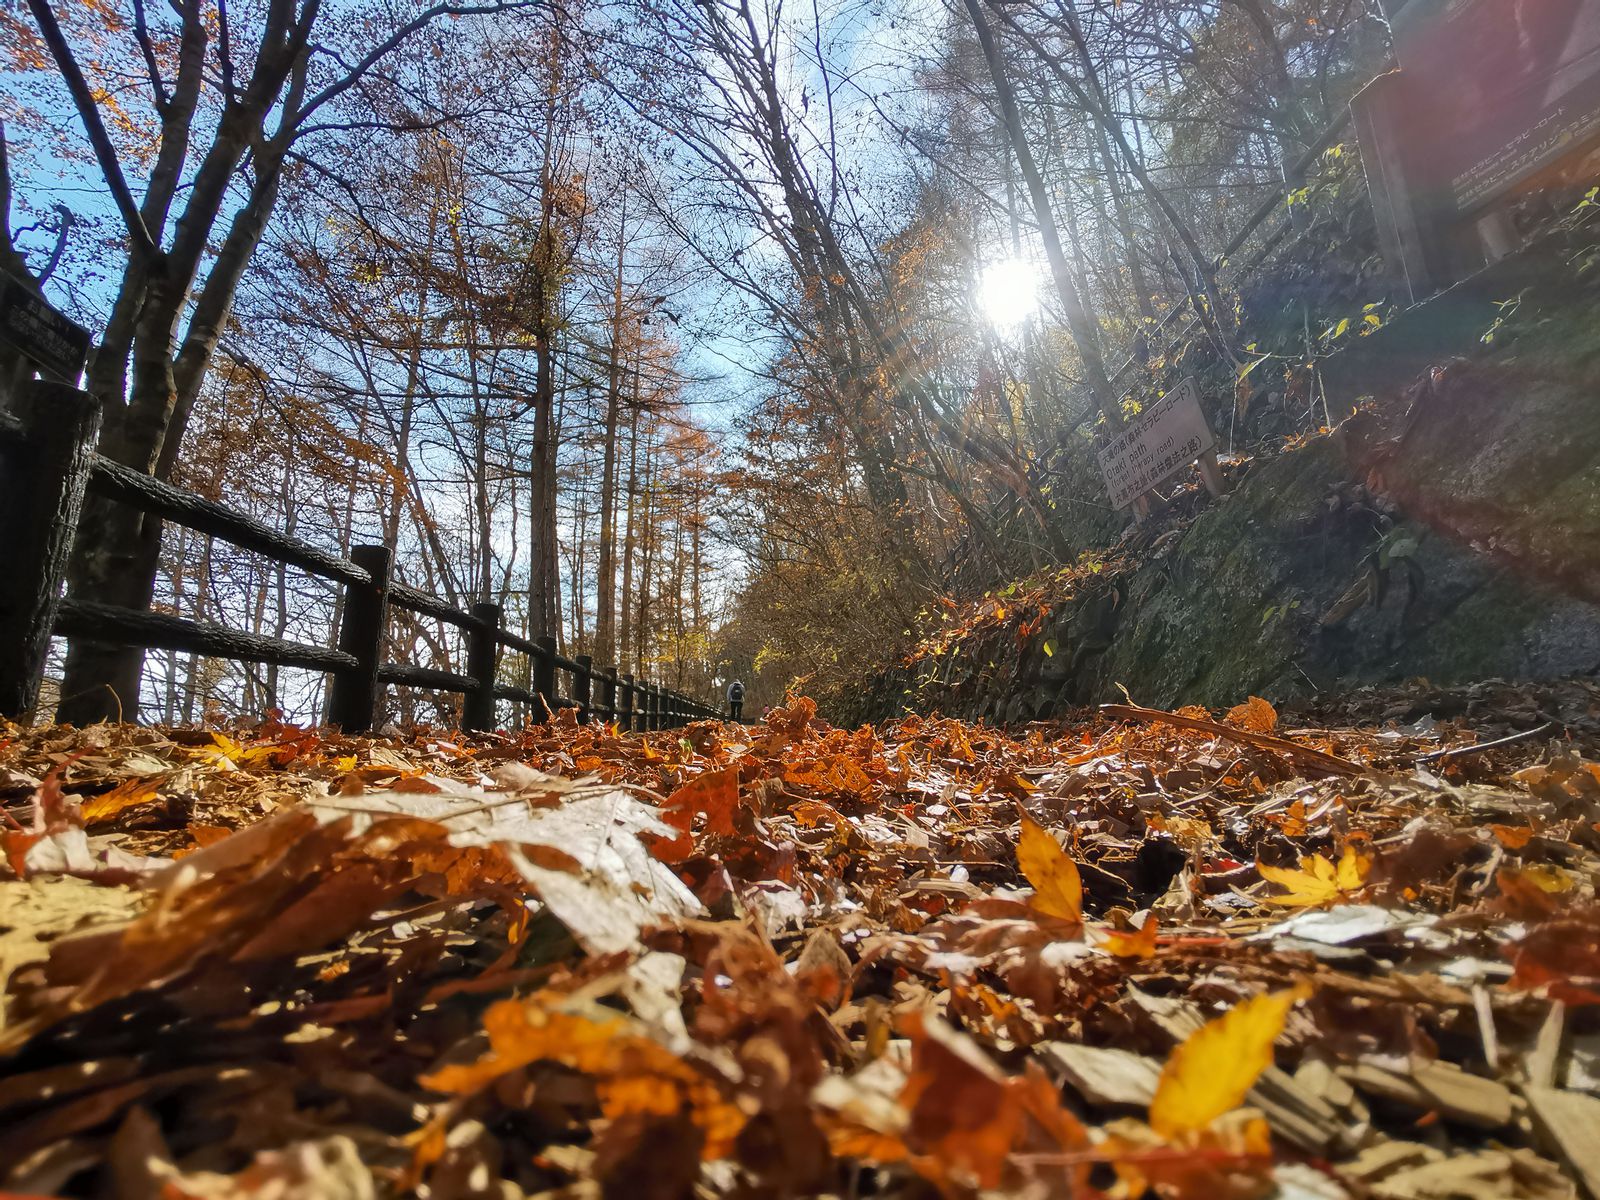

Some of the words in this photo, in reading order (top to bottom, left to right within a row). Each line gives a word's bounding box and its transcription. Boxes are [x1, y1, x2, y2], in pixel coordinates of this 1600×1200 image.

[1156, 435, 1176, 455] road)
[1106, 457, 1128, 480] Otaki
[1129, 443, 1147, 464] path
